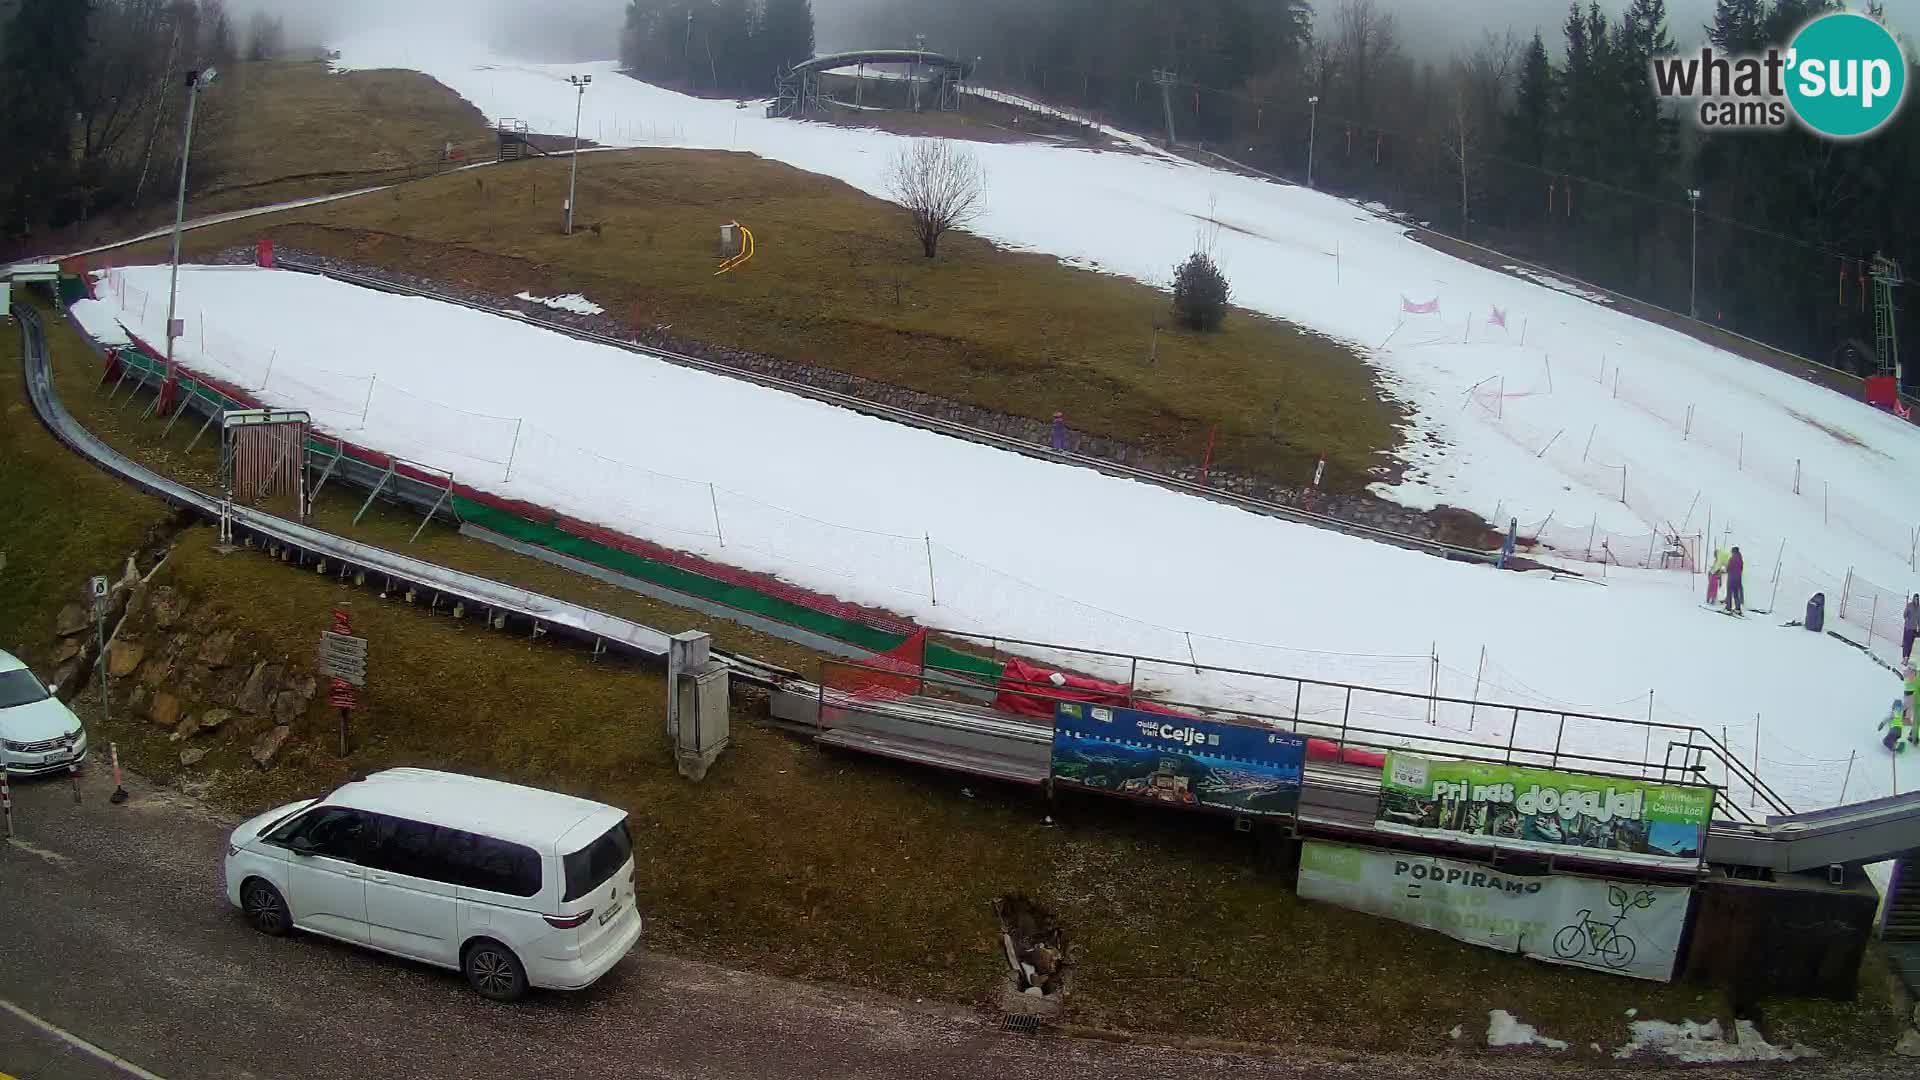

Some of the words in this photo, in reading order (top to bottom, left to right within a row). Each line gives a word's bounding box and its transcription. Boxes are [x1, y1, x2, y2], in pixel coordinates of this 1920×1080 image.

[1159, 723, 1205, 746] Celje
[1431, 779, 1468, 801] Pri
[1472, 782, 1515, 803] nas
[1516, 784, 1644, 822] dogaja!
[1394, 860, 1542, 894] PODPIRAMO
